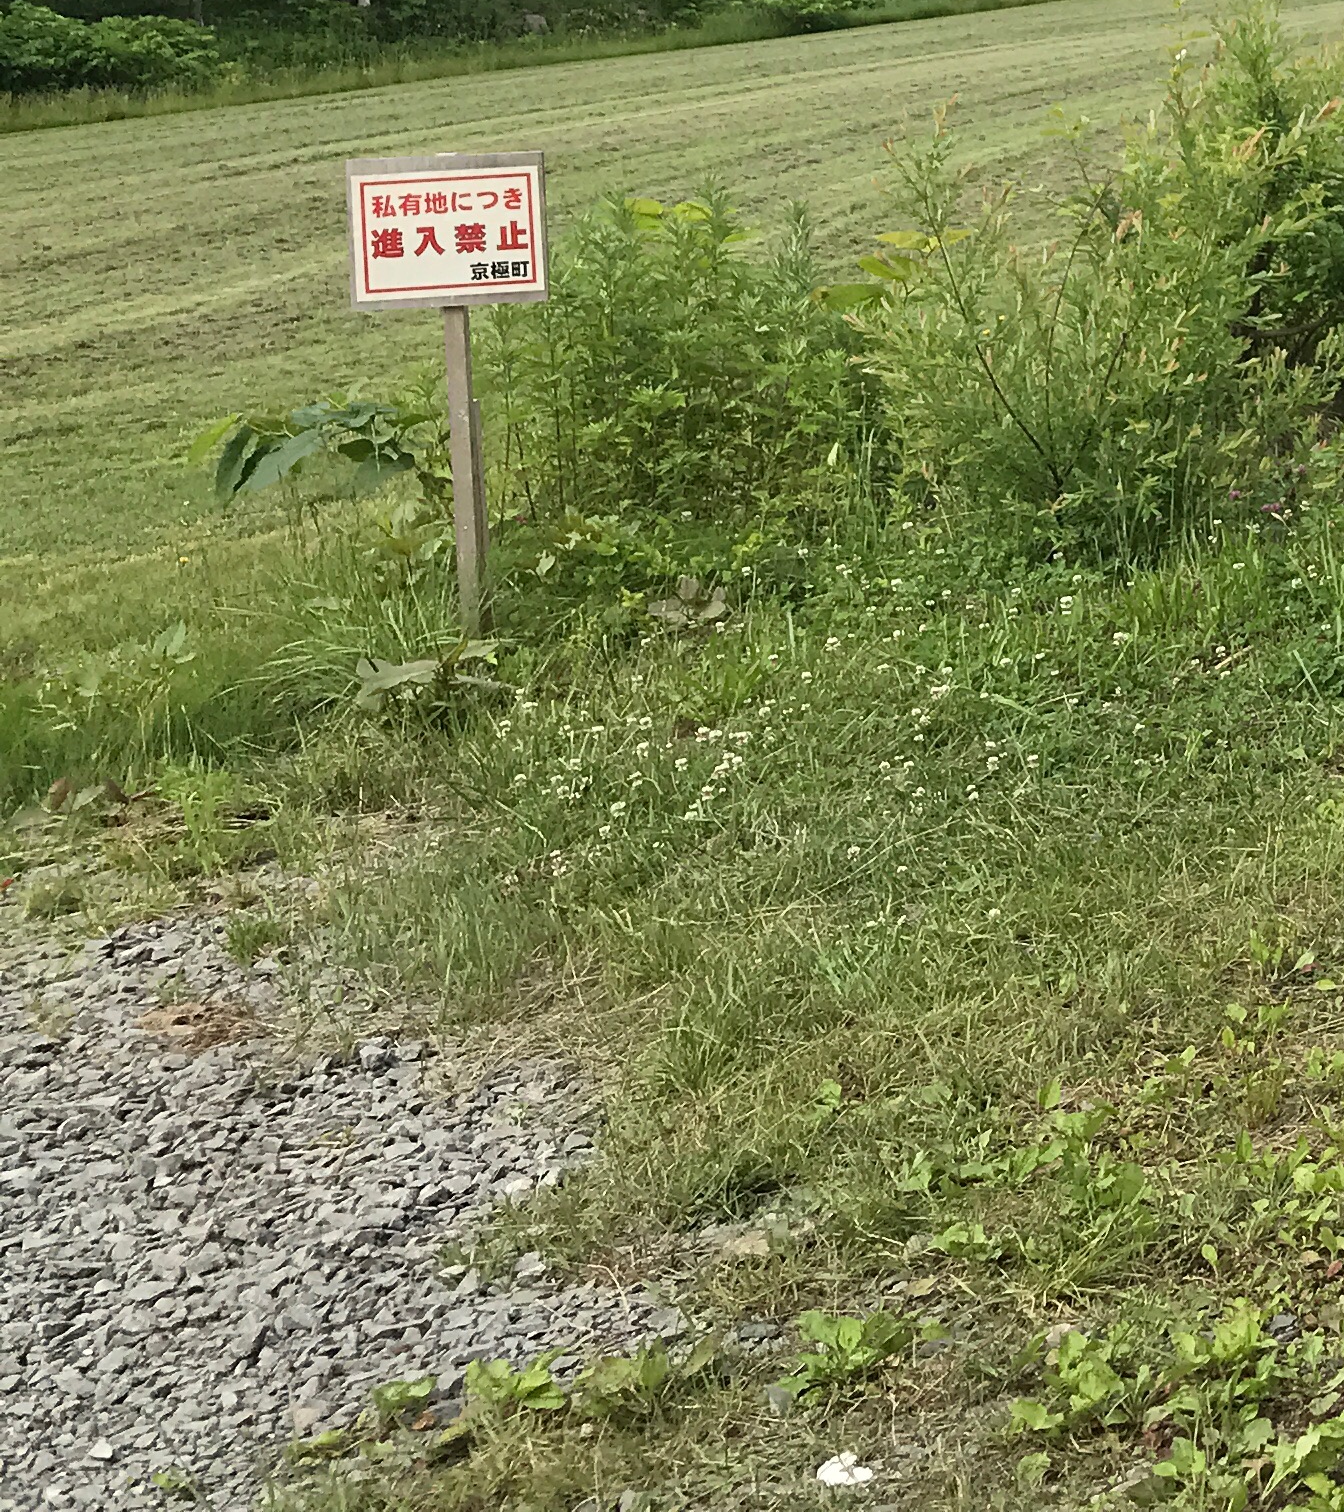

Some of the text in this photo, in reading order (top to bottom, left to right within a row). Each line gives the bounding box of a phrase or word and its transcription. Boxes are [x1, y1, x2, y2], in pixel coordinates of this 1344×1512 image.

[372, 187, 523, 218] 私有地につき
[371, 220, 529, 259] 進入禁止
[470, 260, 530, 281] 京極町
